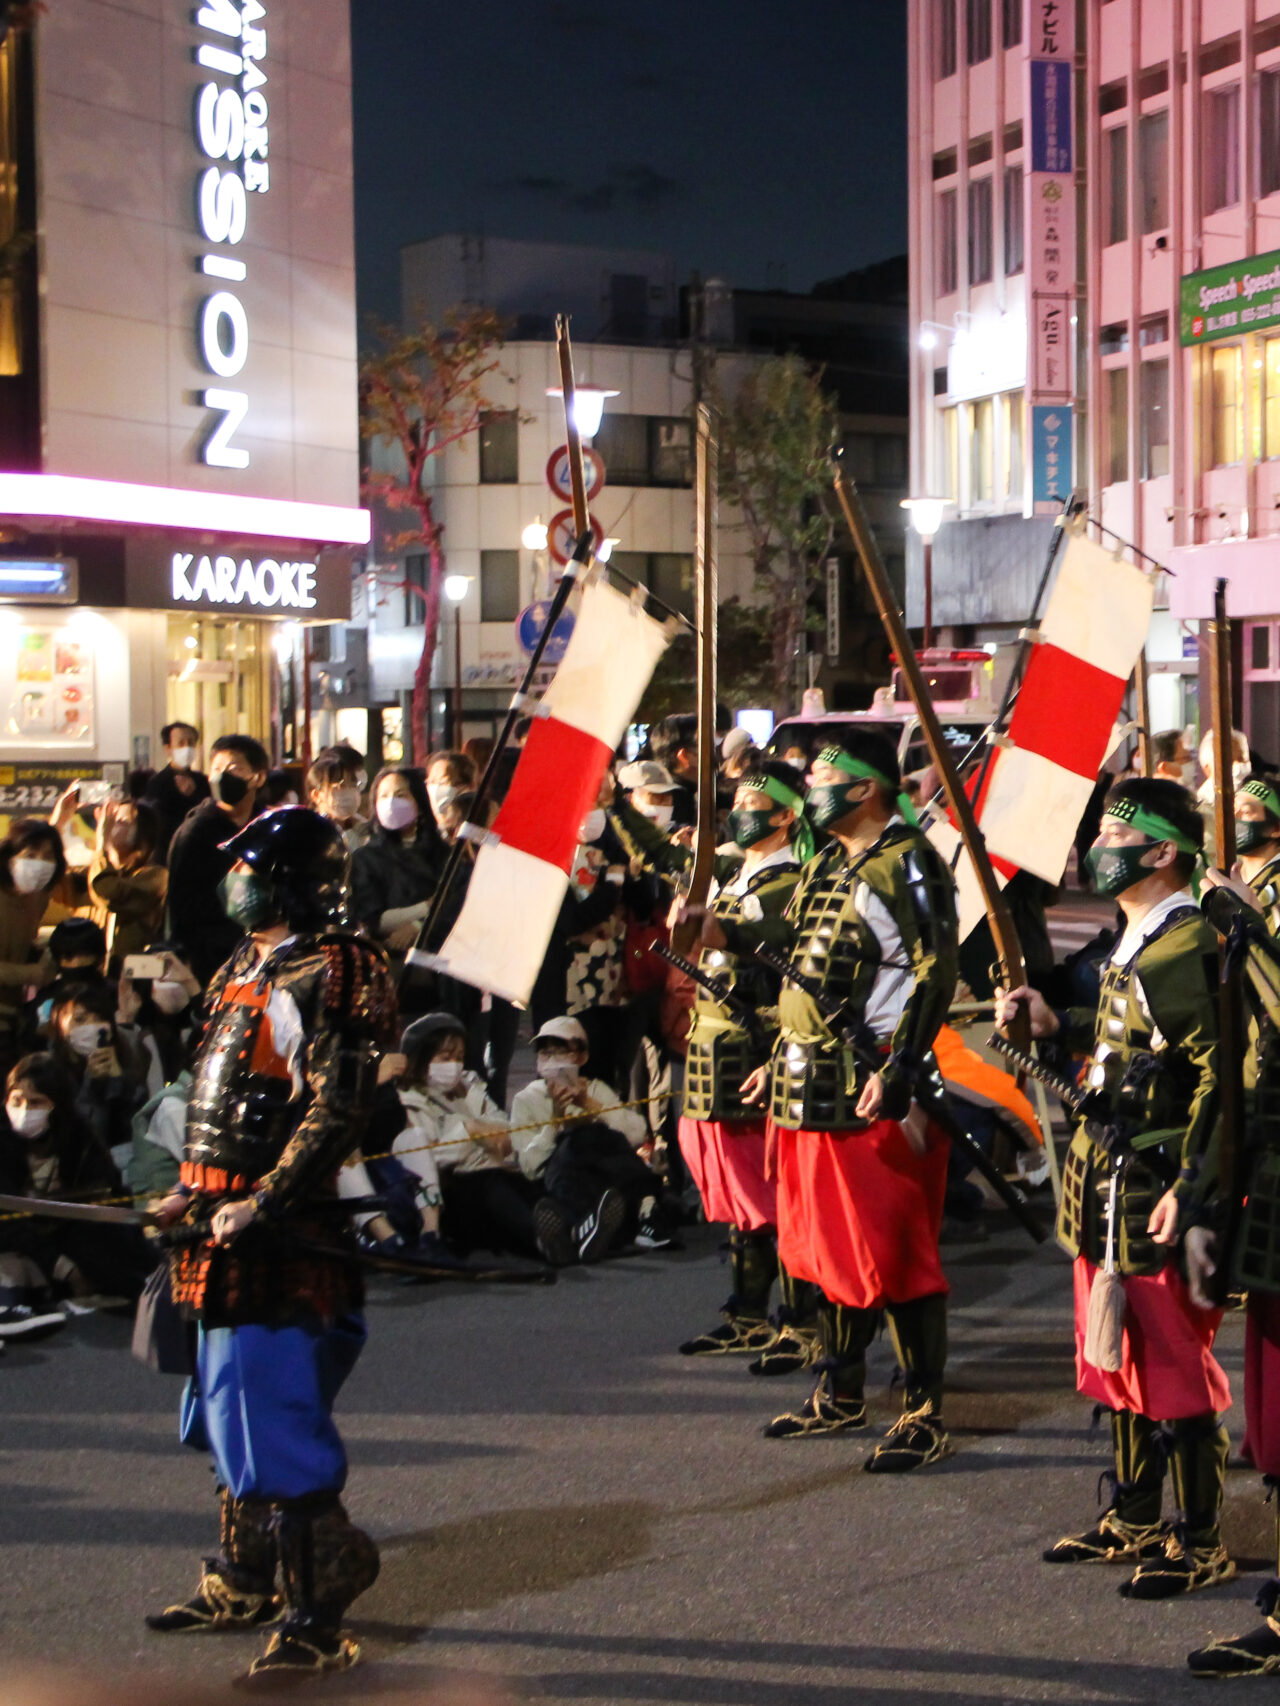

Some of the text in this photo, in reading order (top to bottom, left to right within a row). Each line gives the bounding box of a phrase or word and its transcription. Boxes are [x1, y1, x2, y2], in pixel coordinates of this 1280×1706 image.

[241, 0, 270, 193] ARAOKE
[1199, 277, 1238, 312] Speech
[173, 553, 317, 608] KARAOKE
